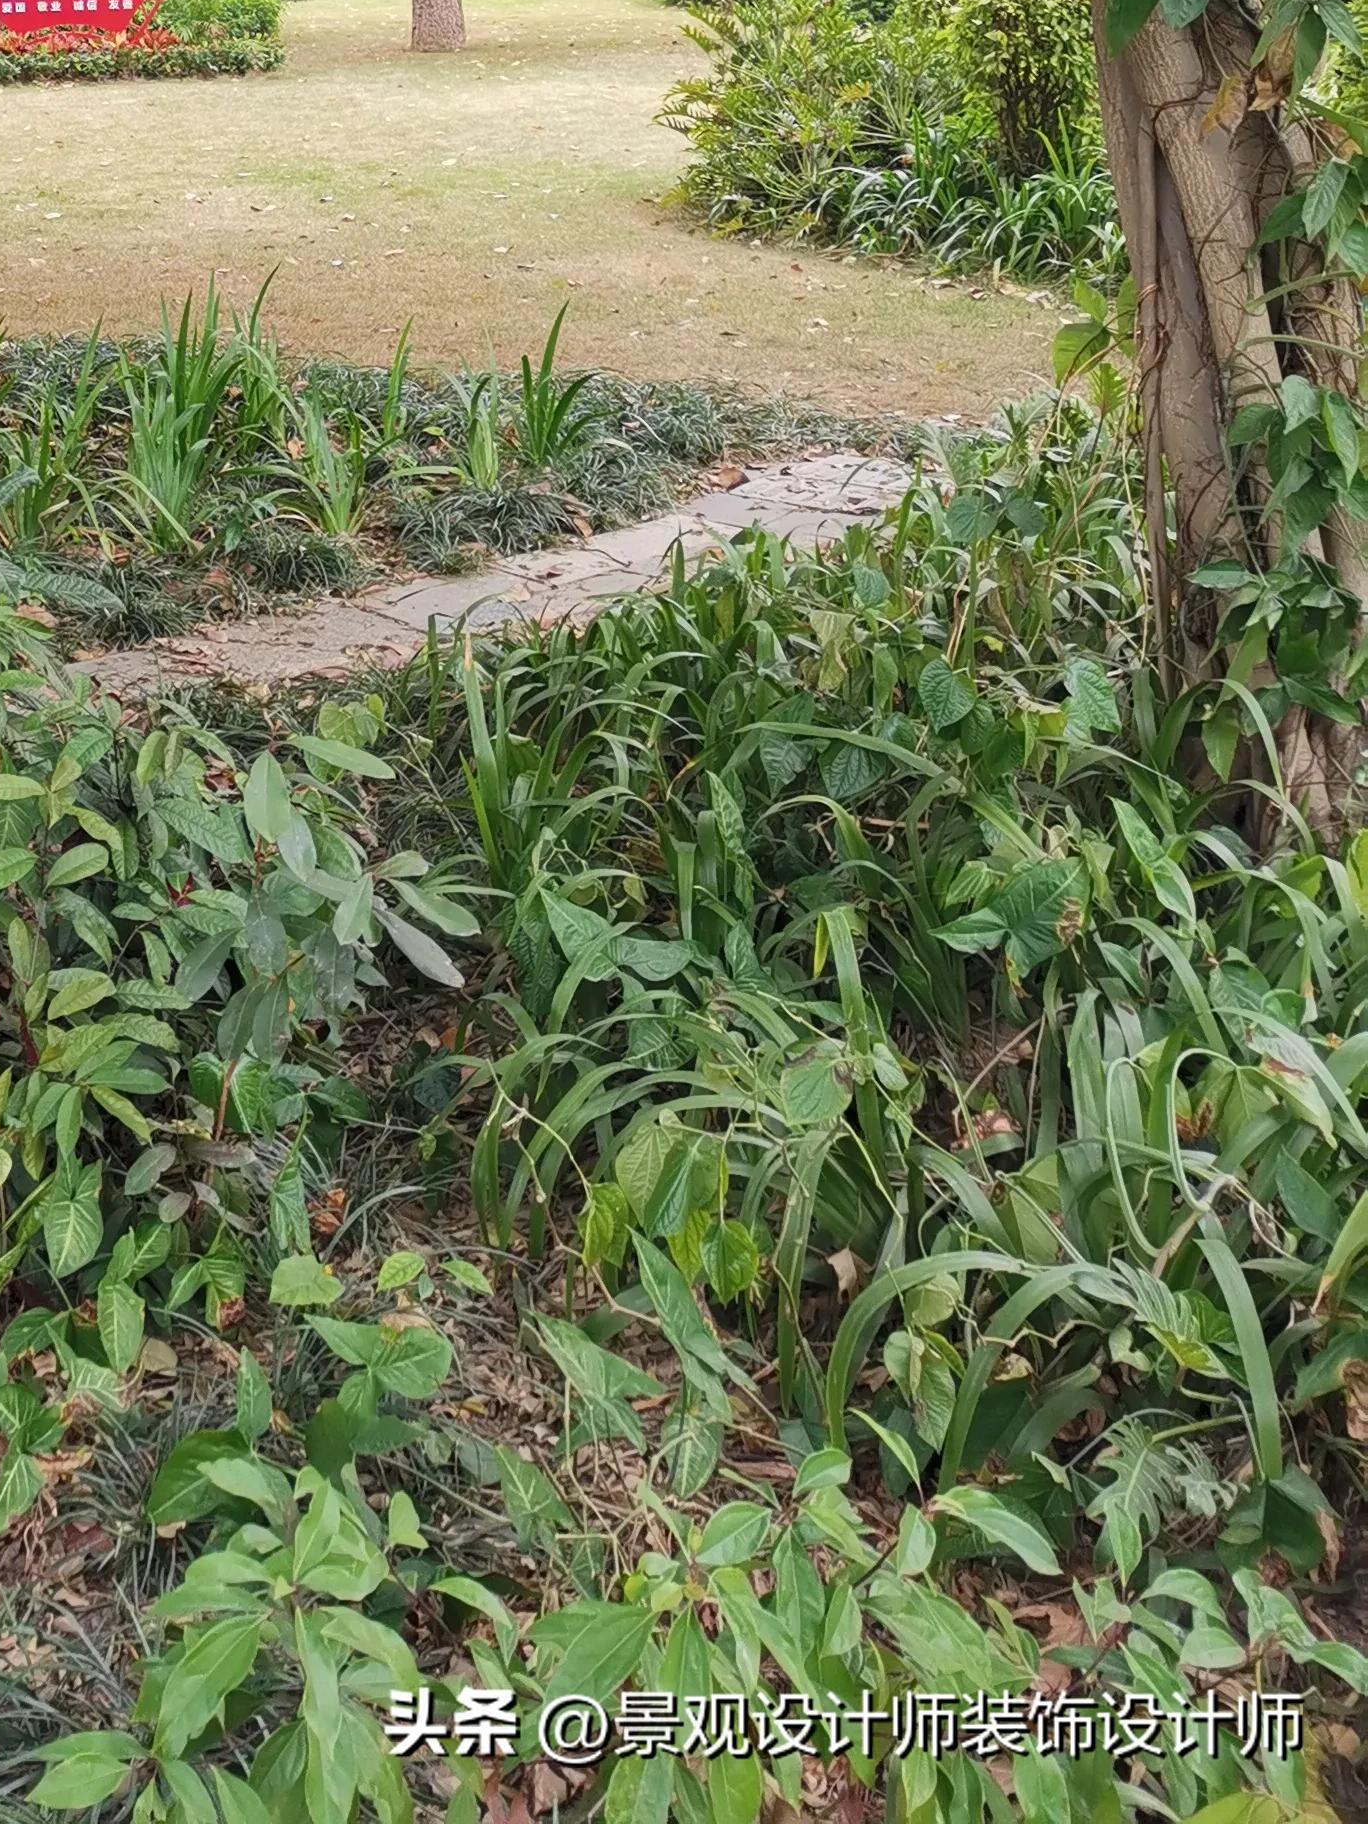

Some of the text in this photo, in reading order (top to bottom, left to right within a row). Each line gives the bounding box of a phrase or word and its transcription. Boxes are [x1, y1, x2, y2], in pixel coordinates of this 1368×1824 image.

[2, 0, 133, 13] 爱国 敬业 诚信 友善
